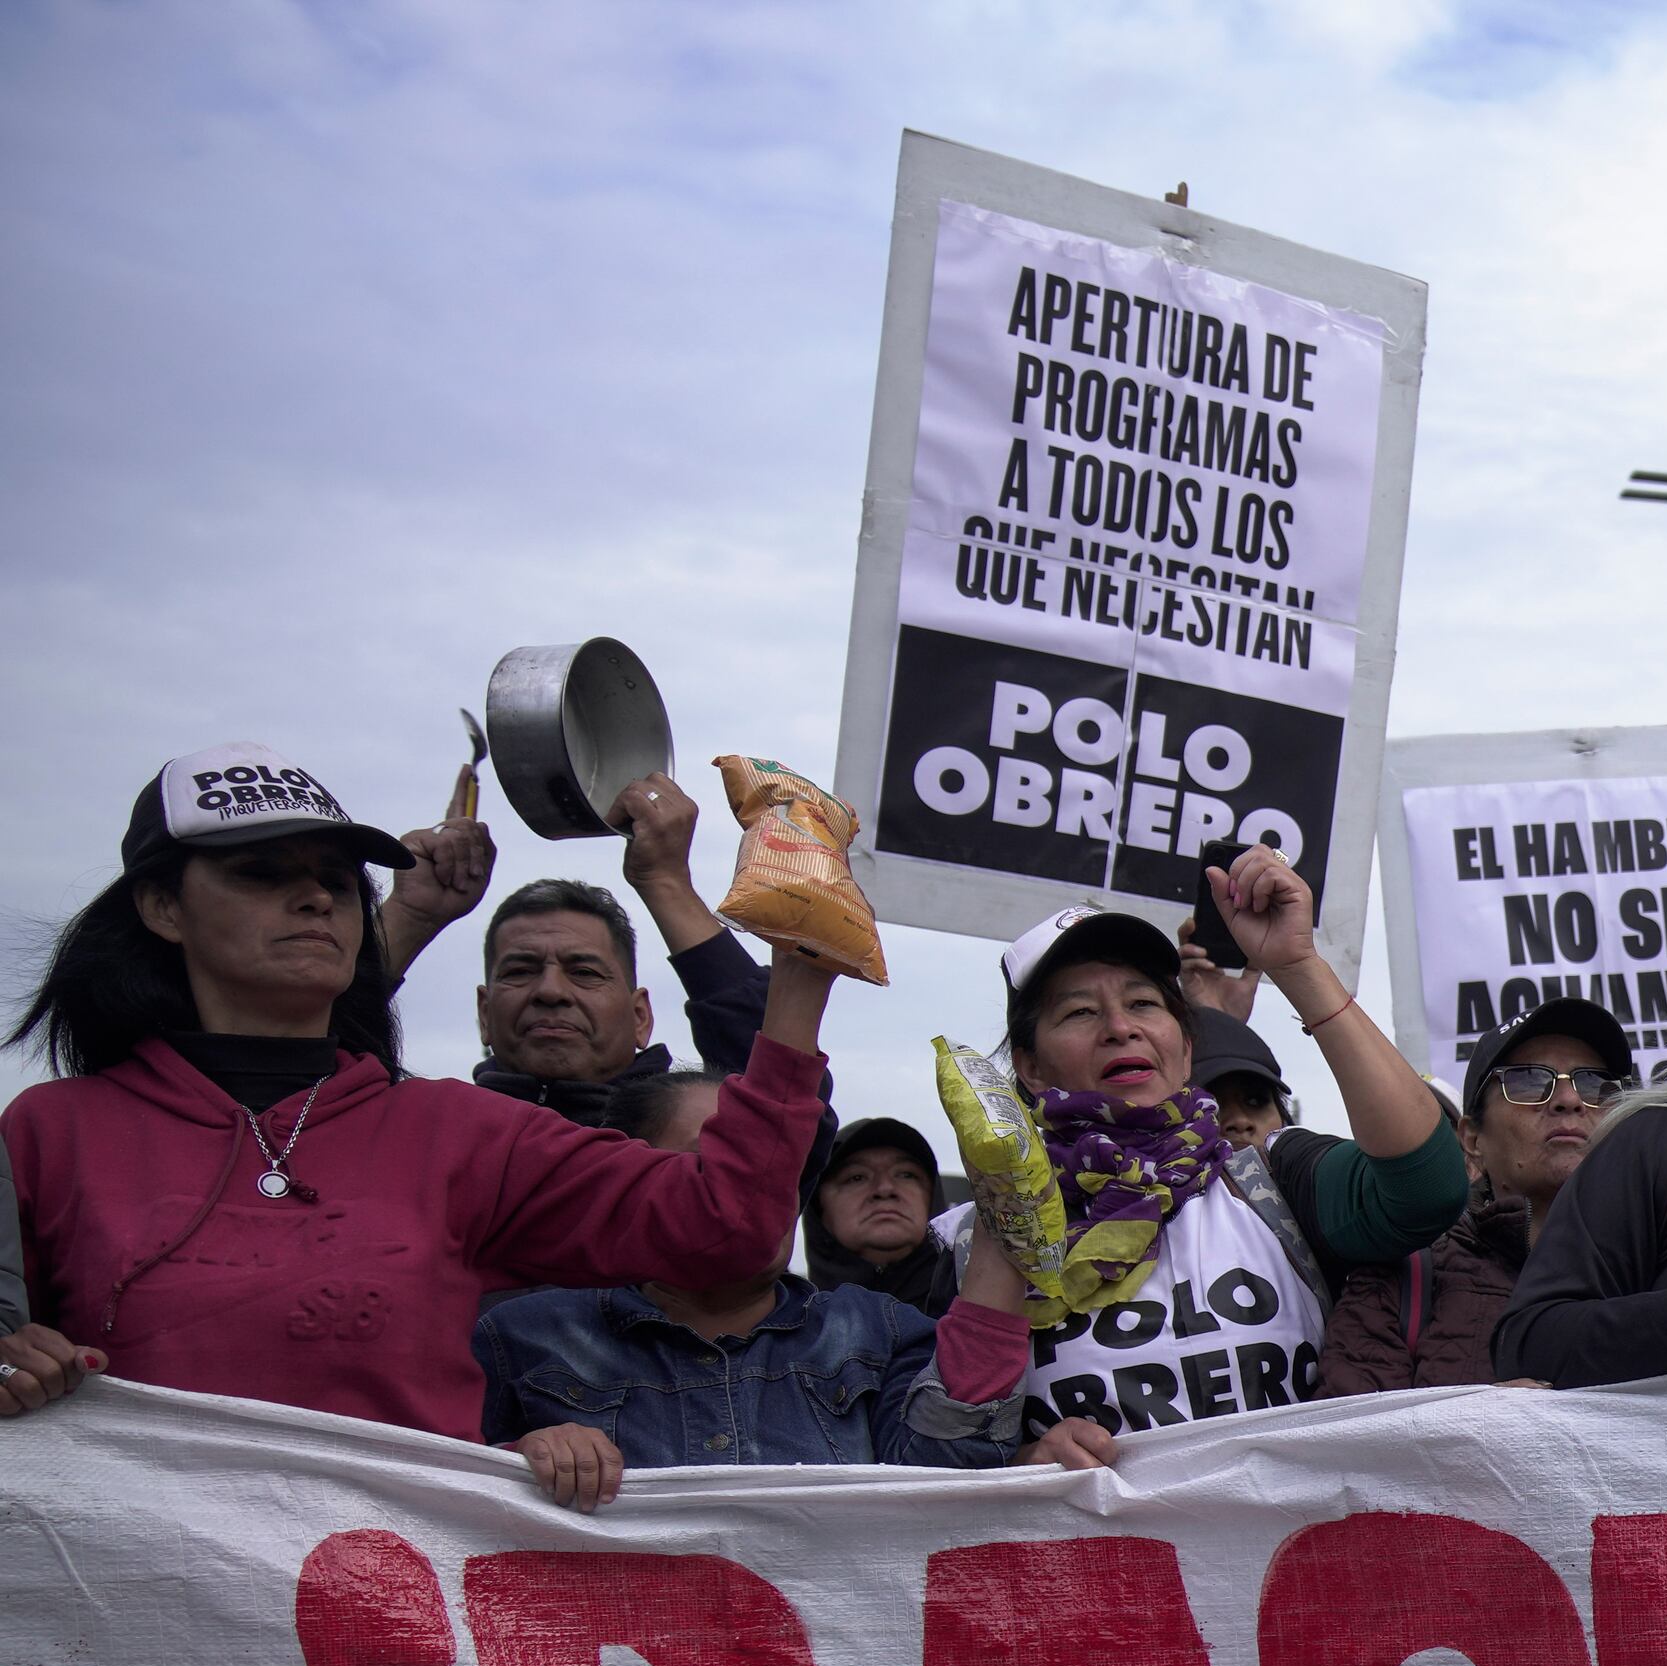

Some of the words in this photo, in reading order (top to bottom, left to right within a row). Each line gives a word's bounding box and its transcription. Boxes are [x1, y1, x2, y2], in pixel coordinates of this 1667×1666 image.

[1008, 267, 1249, 393] APERTURA
[1262, 332, 1317, 411] DE
[1012, 351, 1301, 489] PROGRAMAS
[999, 438, 1028, 509] A
[1047, 448, 1200, 550] TODOS
[1213, 487, 1293, 571] LOS
[954, 515, 1055, 608] QUE
[1061, 541, 1316, 671] NECESITAN
[192, 765, 311, 792] POLO
[988, 679, 1252, 793] POLO
[913, 744, 1303, 869] OBRERO
[1453, 826, 1504, 881] EL
[1503, 891, 1598, 966] NO
[1033, 1267, 1280, 1370] POLO
